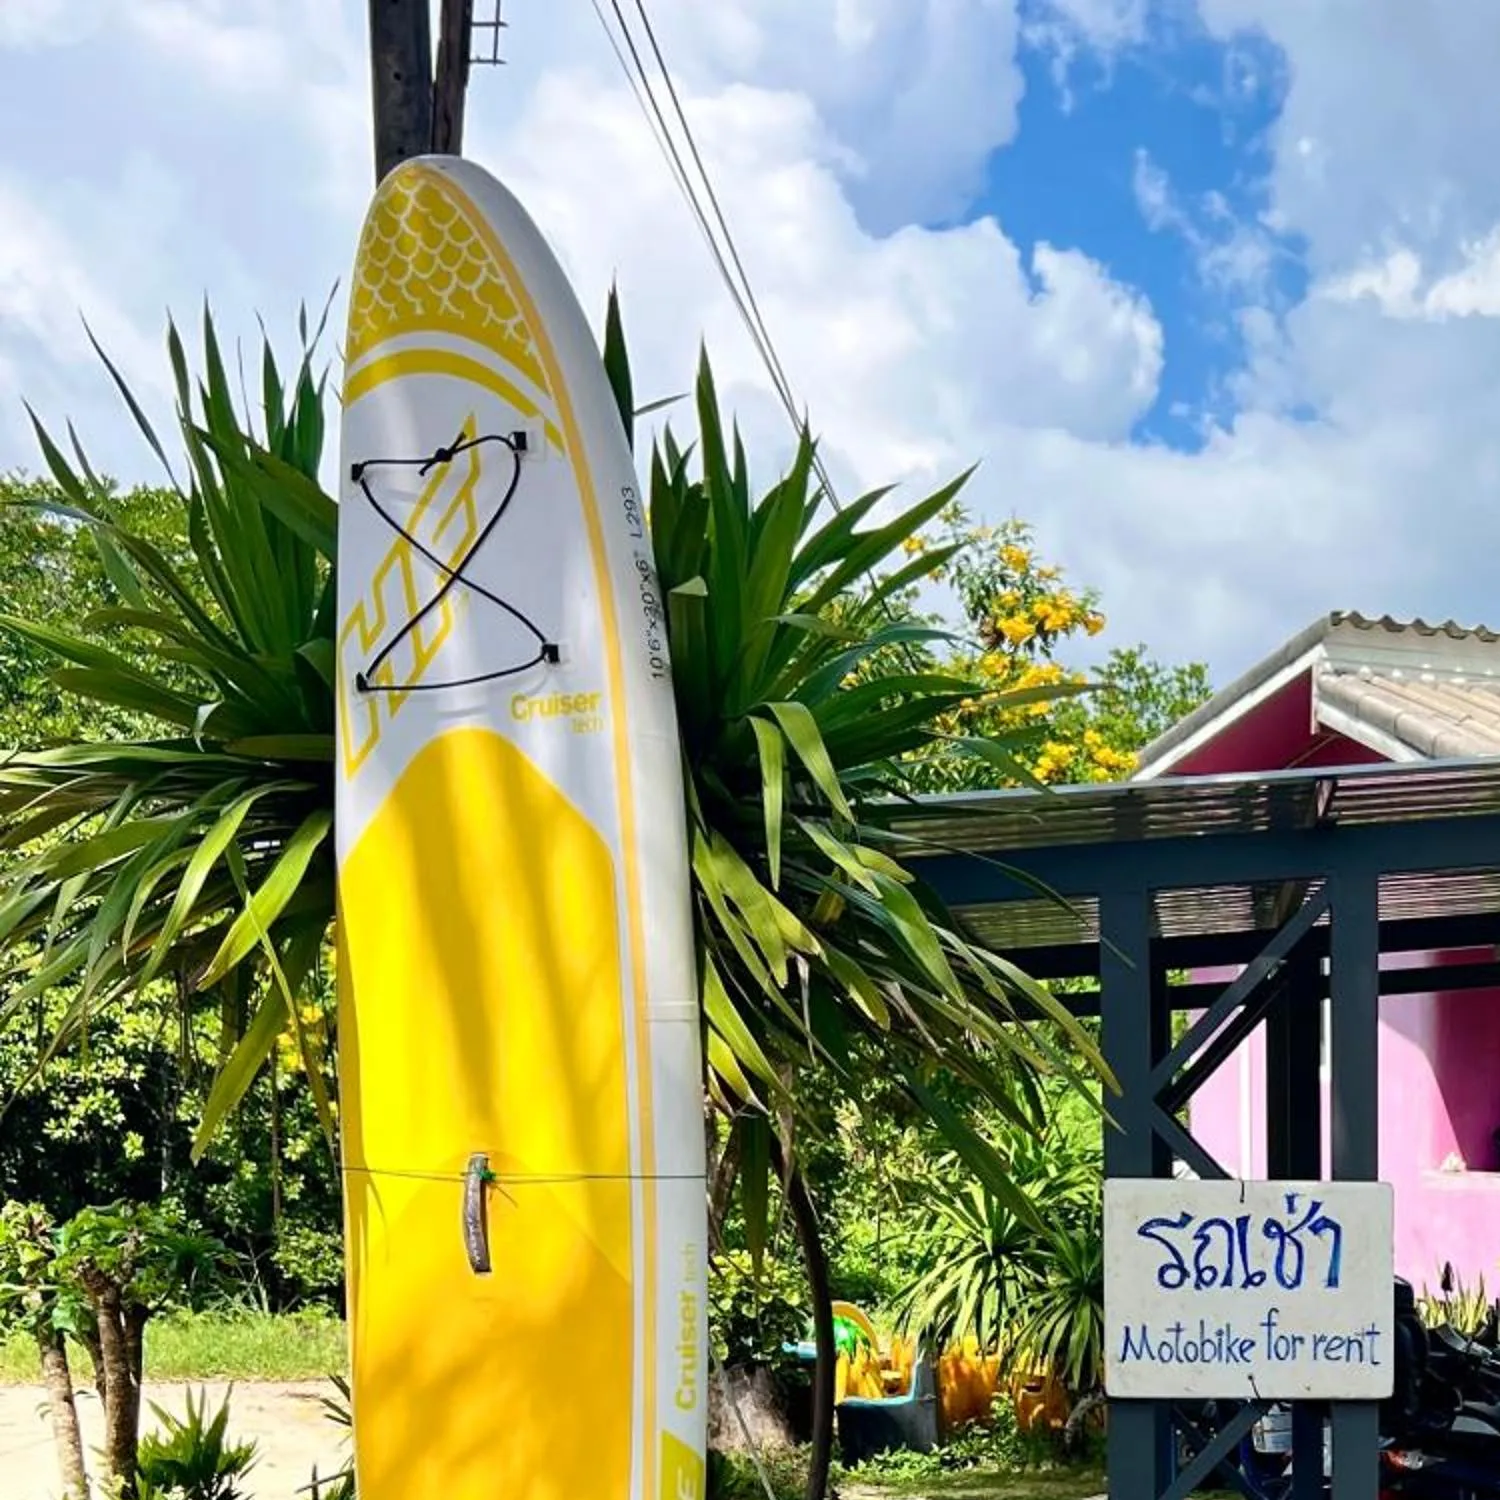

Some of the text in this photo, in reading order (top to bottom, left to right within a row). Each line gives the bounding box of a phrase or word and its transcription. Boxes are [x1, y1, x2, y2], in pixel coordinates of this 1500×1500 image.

[621, 485, 643, 540] L293
[510, 690, 601, 721] Cruiser
[1137, 1191, 1342, 1290] รถเช่า
[675, 1289, 697, 1411] Cruiser
[1119, 1307, 1381, 1365] Motobike for rent
